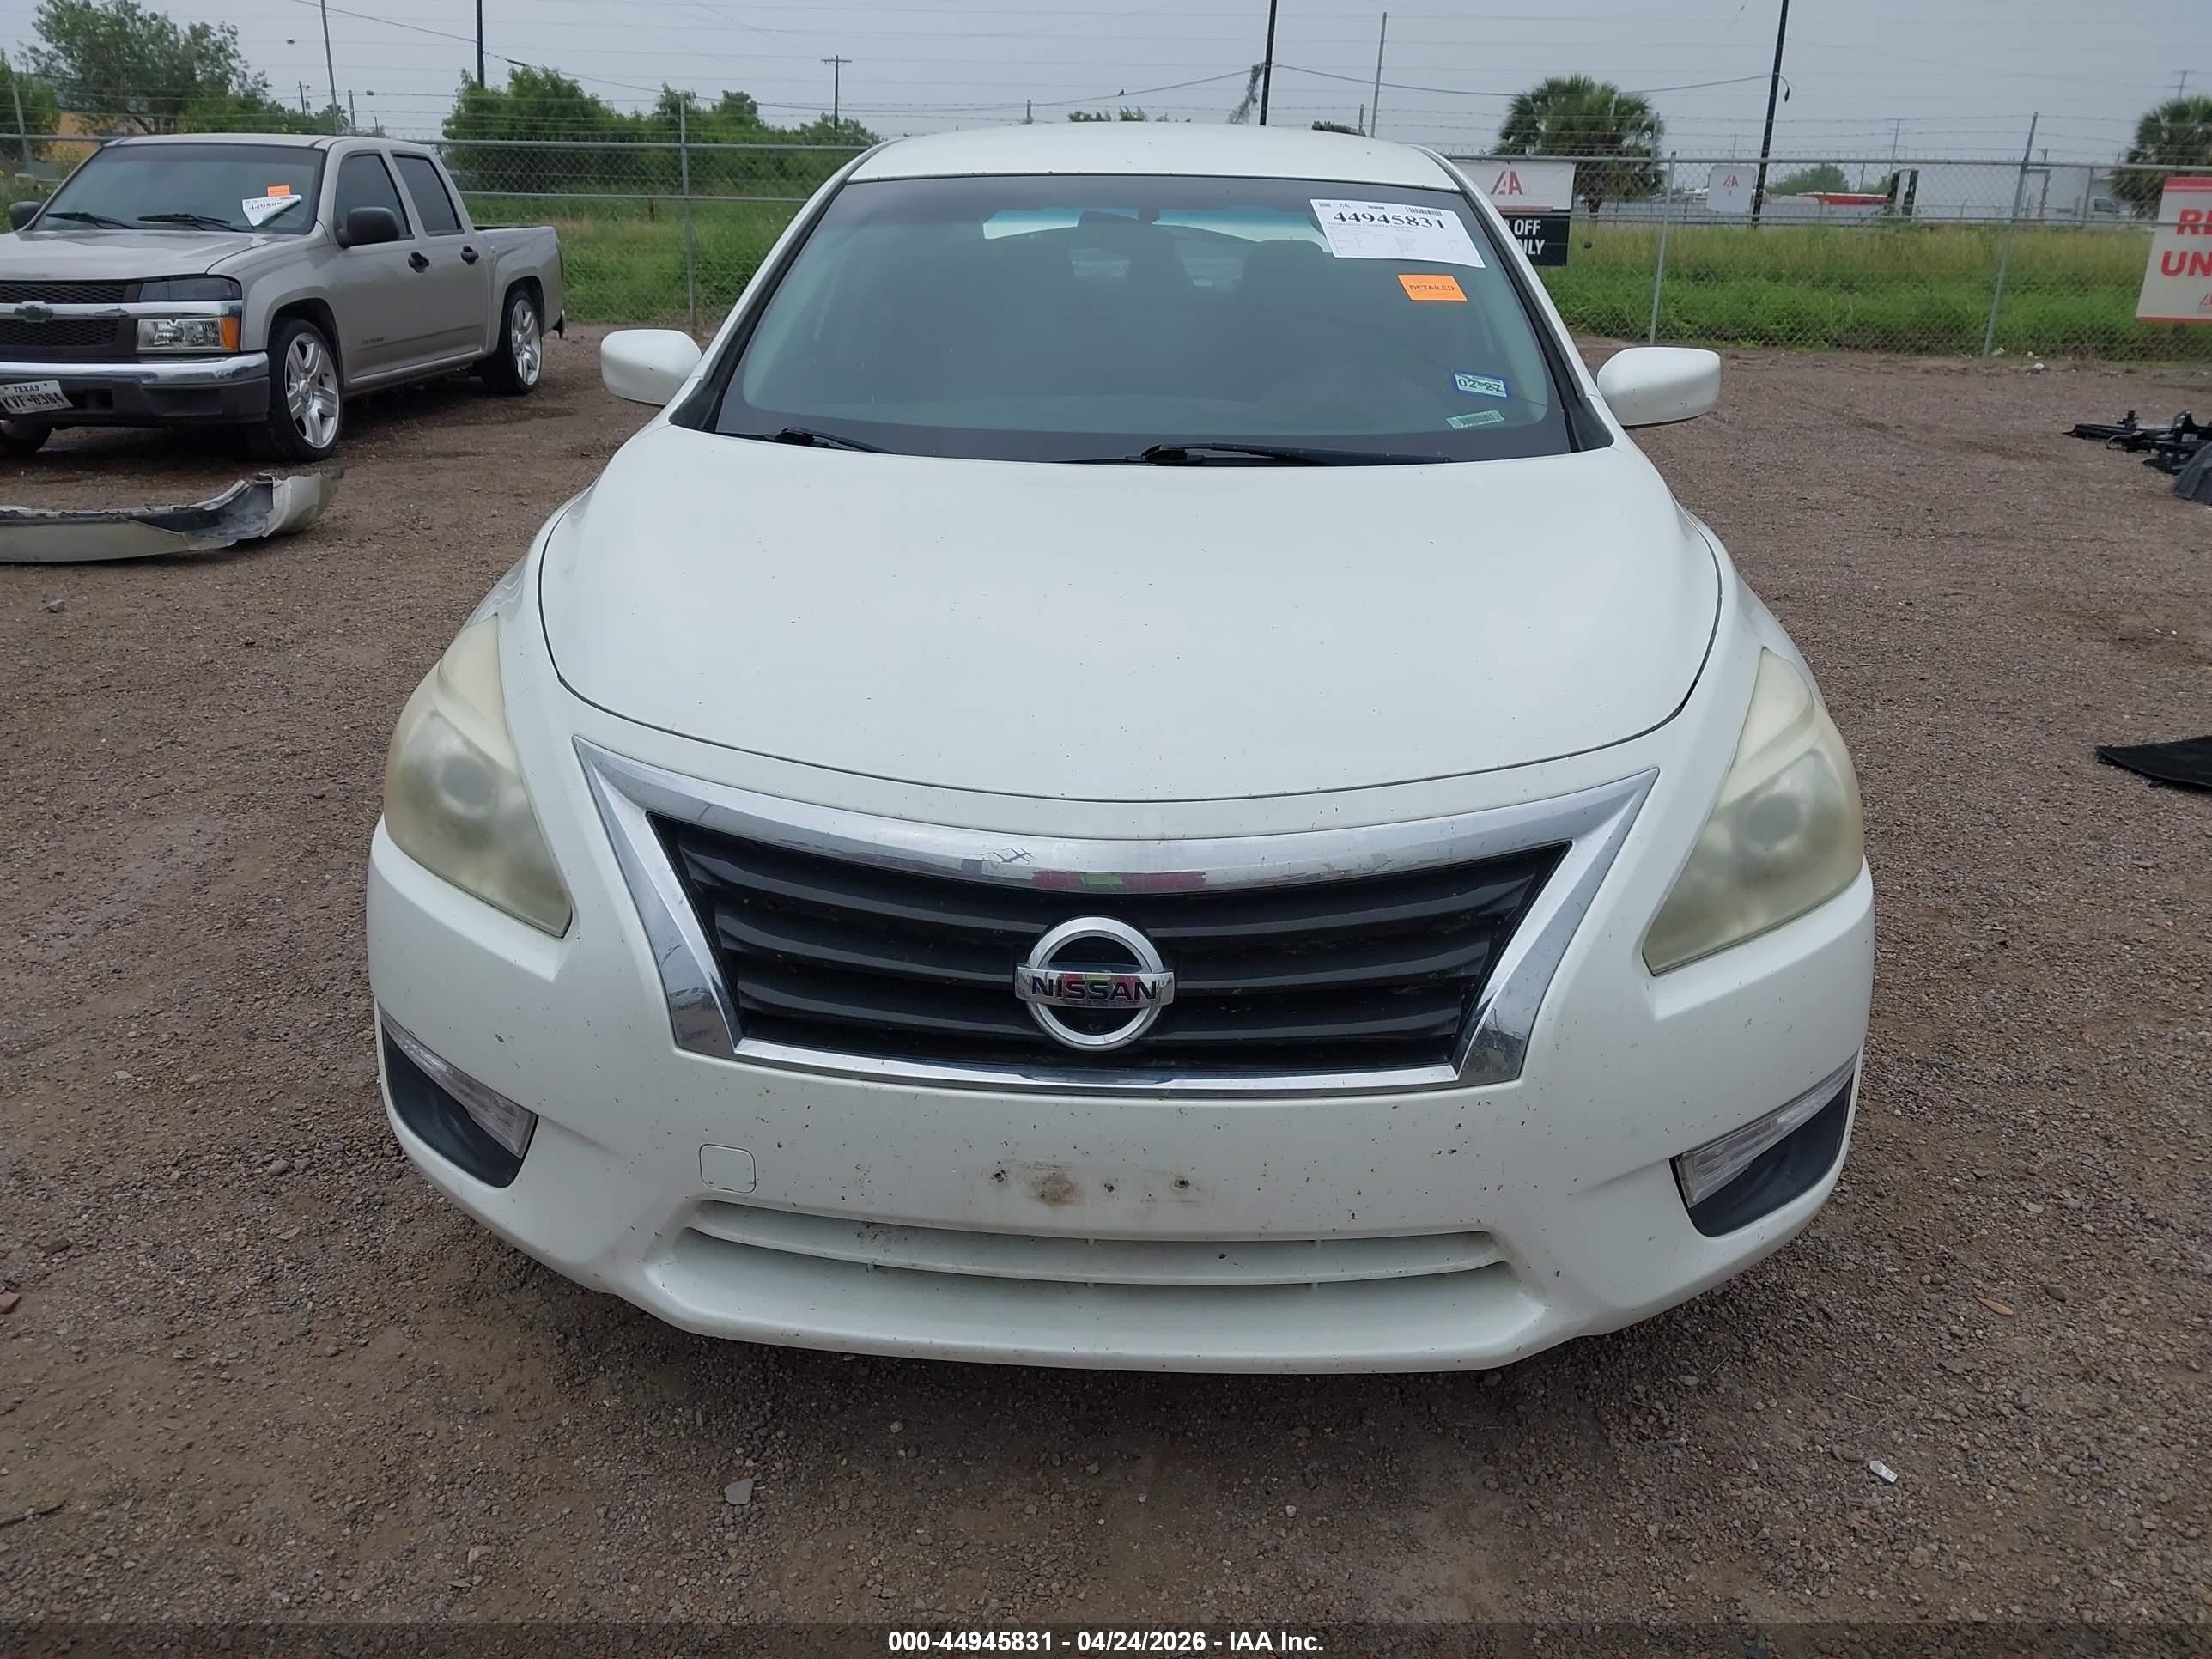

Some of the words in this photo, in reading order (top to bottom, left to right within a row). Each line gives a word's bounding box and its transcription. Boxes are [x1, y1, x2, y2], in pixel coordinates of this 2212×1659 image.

[1334, 211, 1445, 229] 44945831
[1513, 218, 1542, 236] OFF
[14, 384, 40, 392] TEXAS
[1031, 975, 1158, 1002] NISSAN
